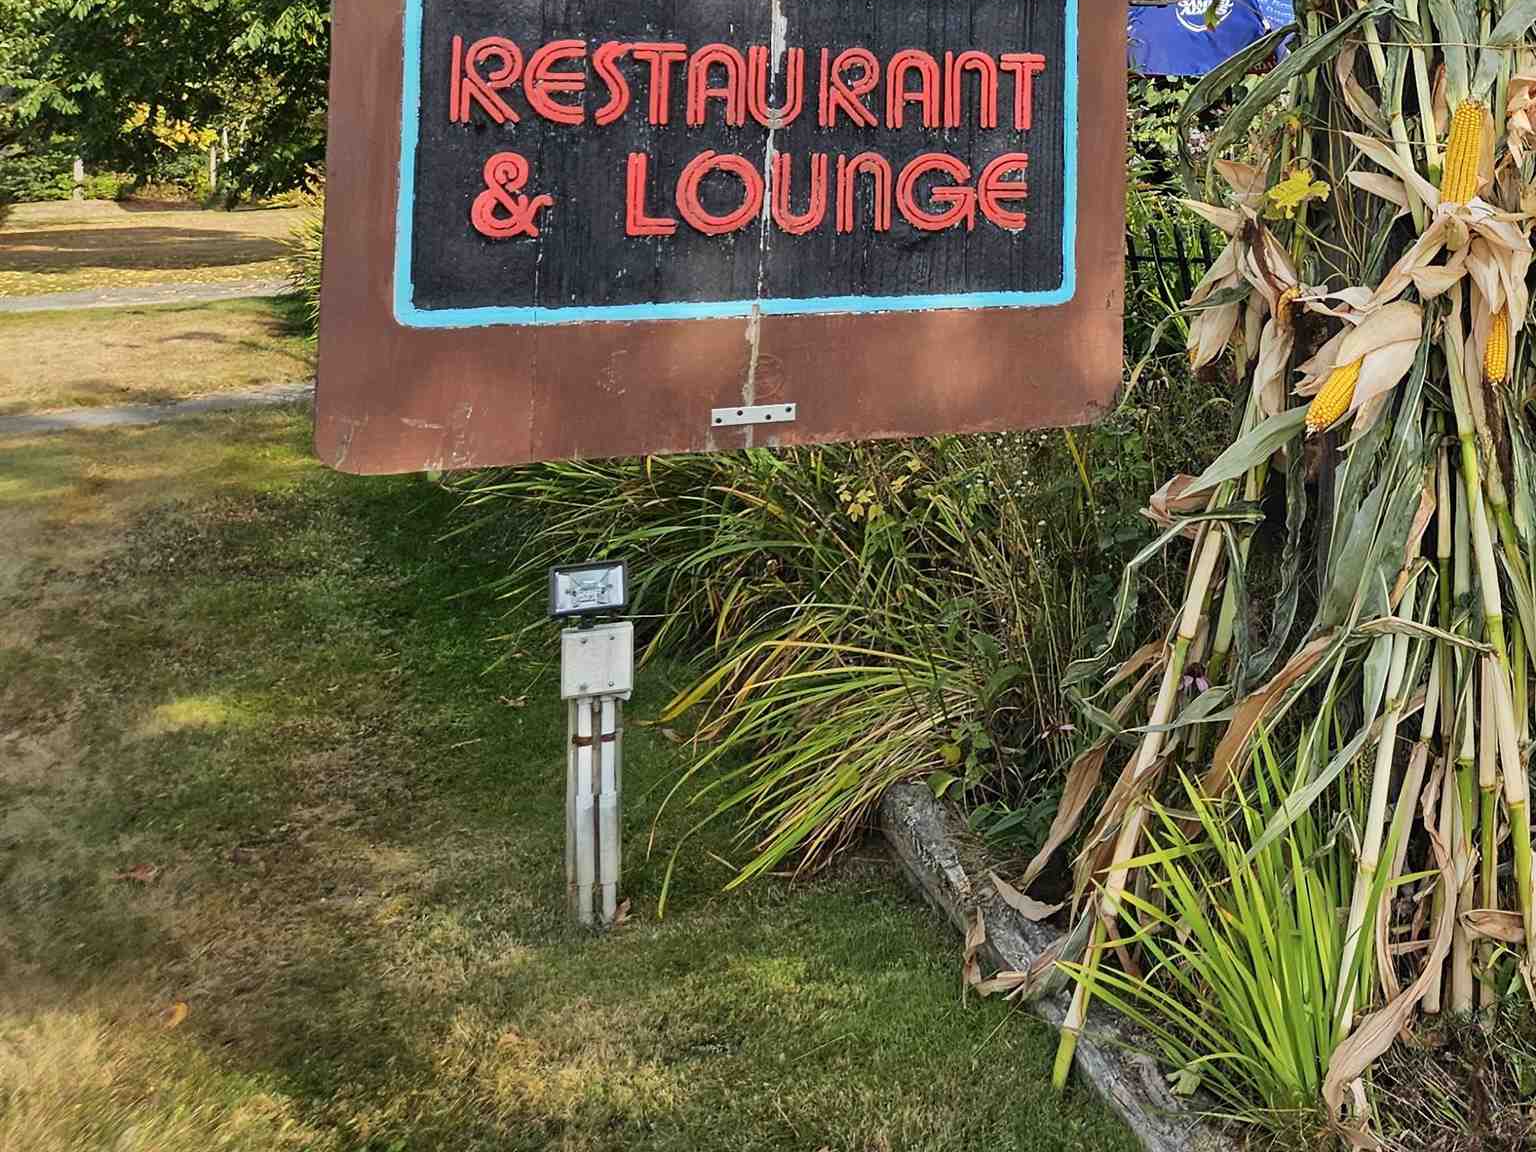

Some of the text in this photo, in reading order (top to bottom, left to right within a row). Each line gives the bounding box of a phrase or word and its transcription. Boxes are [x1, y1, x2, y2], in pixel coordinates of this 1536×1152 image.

[449, 34, 1046, 128] RESTAURANT
[471, 149, 1029, 238] & LOUNGE
